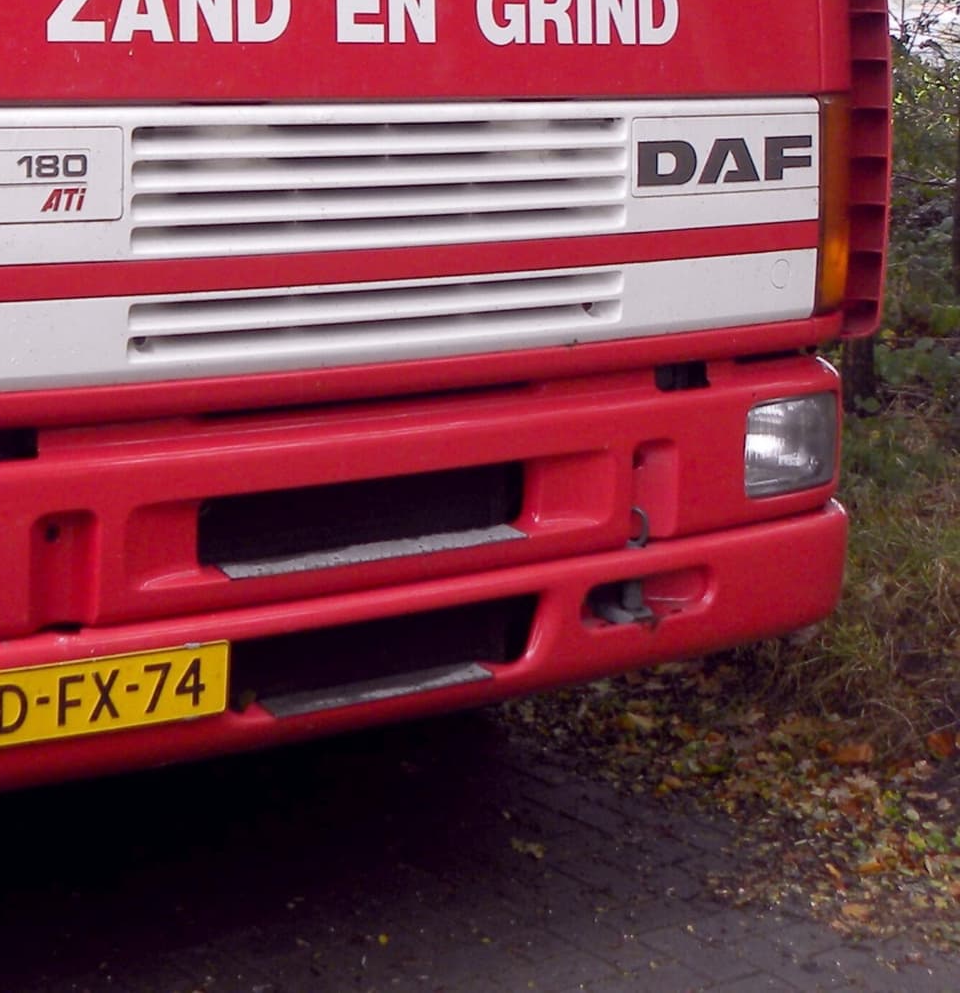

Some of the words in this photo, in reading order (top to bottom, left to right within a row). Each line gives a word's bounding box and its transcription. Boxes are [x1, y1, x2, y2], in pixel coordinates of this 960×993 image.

[16, 154, 88, 178] 180
[636, 135, 814, 188] DAF
[40, 188, 87, 212] ATi
